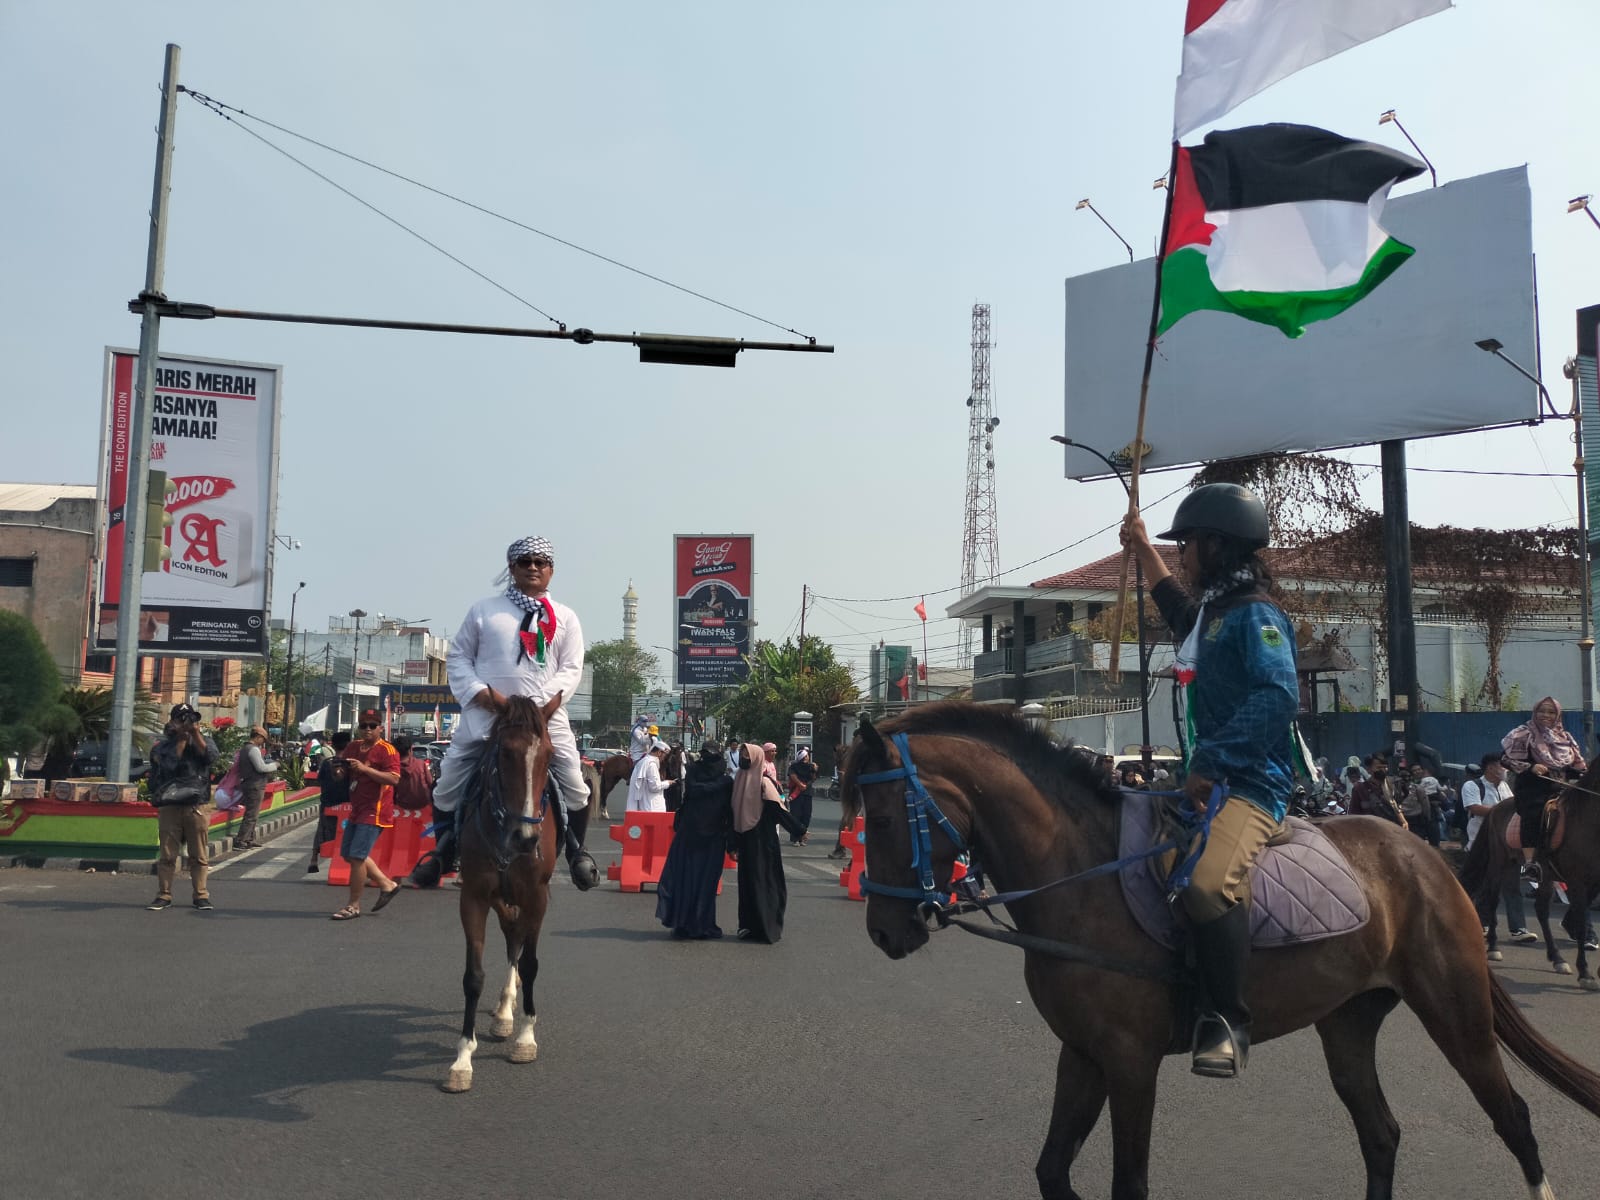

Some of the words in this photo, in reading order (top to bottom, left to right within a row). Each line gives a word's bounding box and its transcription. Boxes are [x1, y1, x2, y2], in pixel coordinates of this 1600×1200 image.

[155, 368, 191, 389] ARIS
[196, 372, 256, 395] MERAH
[117, 392, 128, 429] EDITION
[153, 395, 217, 418] ASANYA
[152, 417, 217, 440] AMAAA!
[116, 430, 127, 452] ICON
[115, 454, 125, 473] THE
[172, 561, 193, 571] ICON
[194, 566, 228, 579] EDITION
[192, 621, 239, 629] PERINGATAN:
[715, 628, 735, 636] FALS
